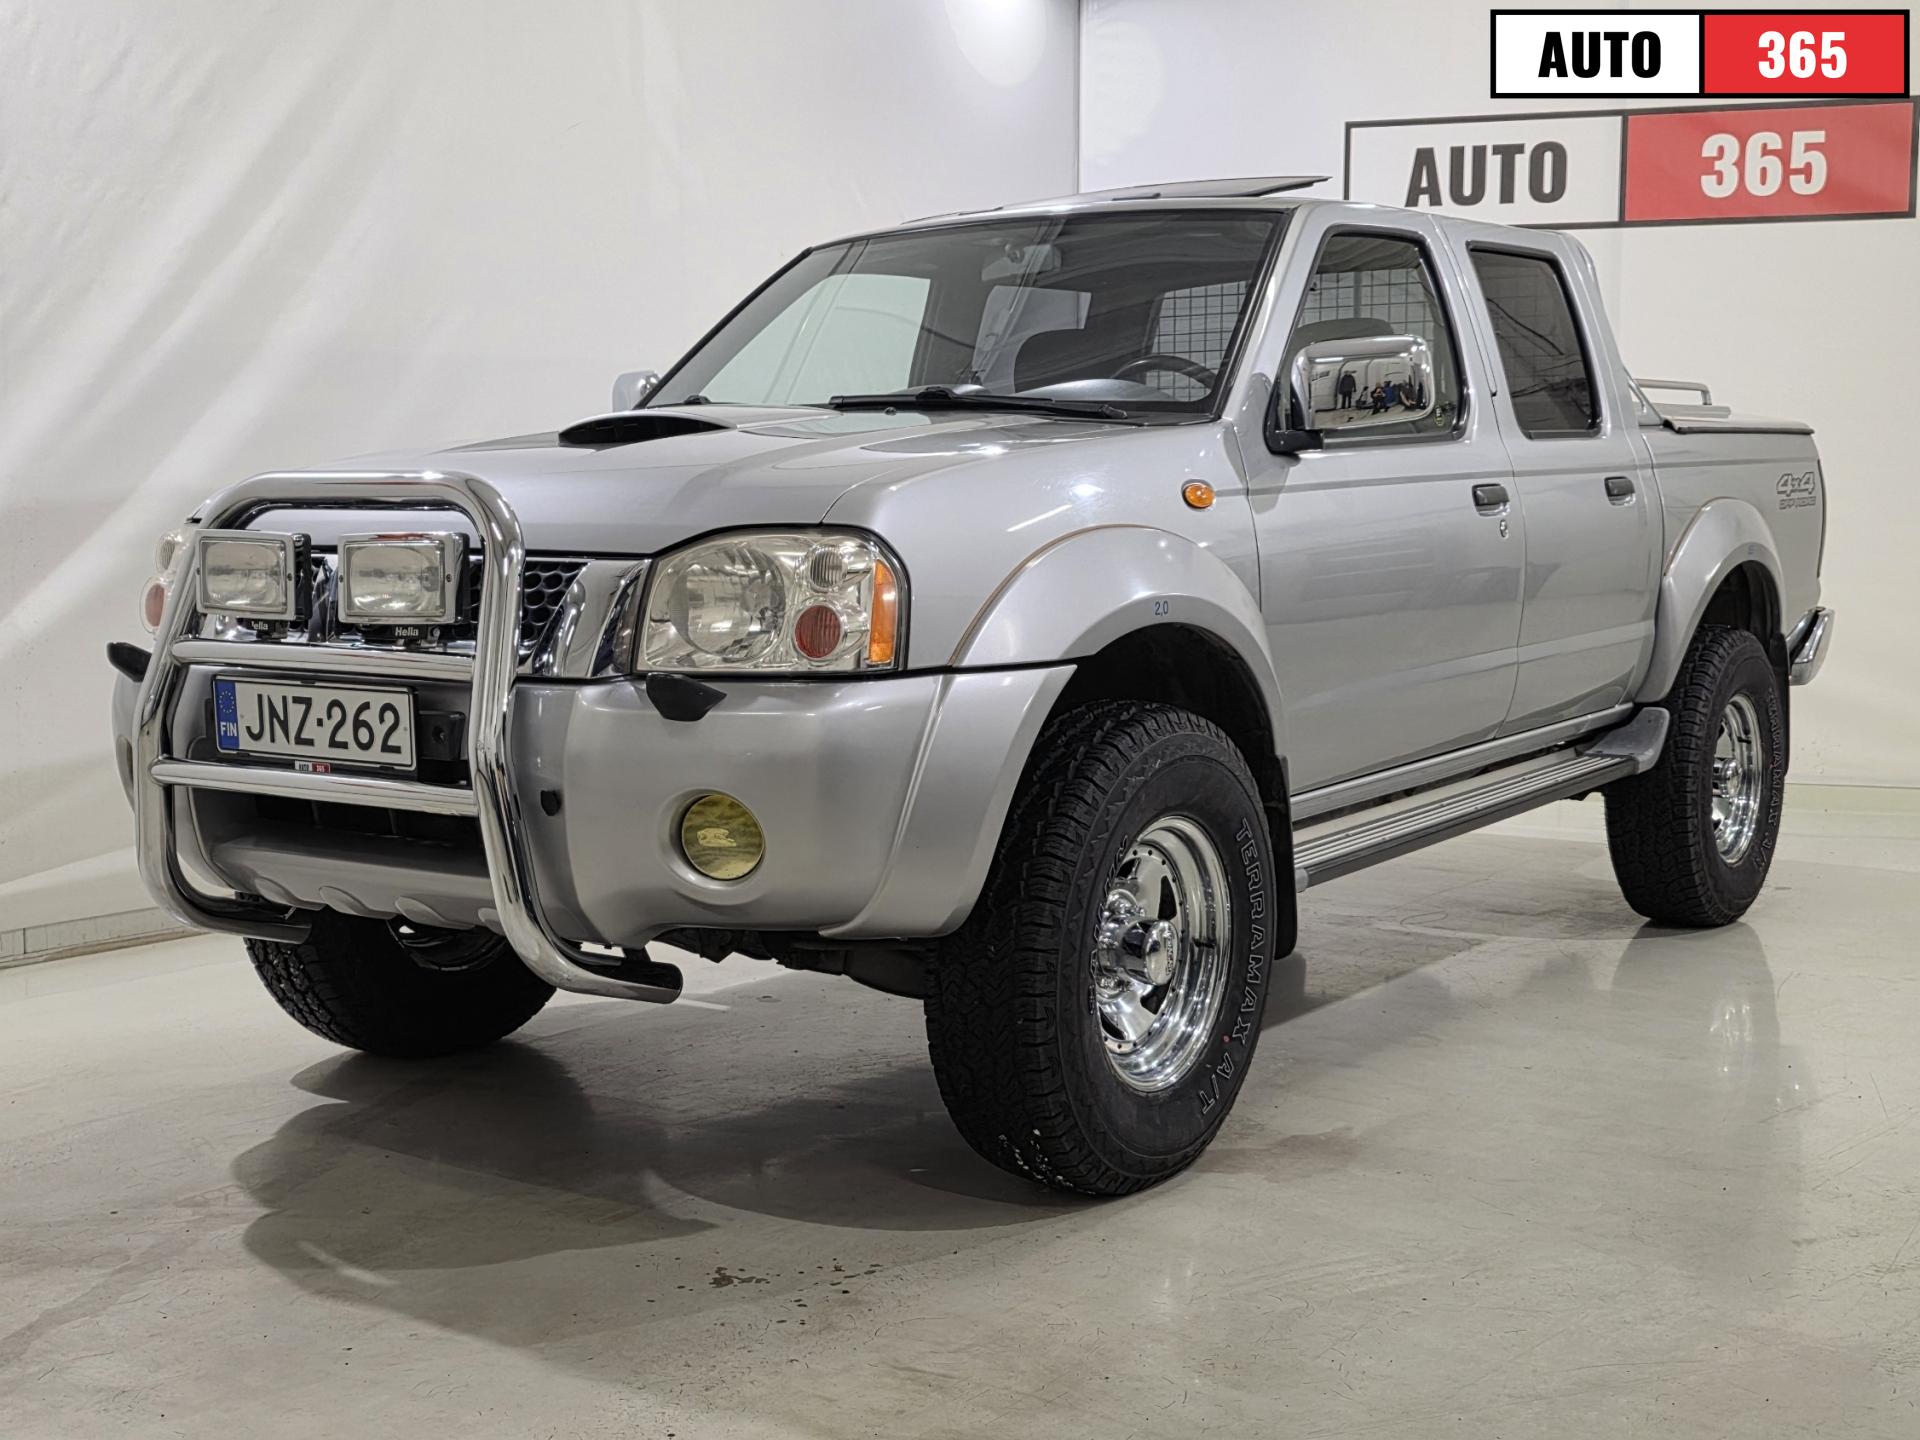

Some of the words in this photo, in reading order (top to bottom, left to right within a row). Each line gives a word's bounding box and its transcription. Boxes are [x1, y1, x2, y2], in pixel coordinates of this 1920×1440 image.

[1404, 141, 1568, 208] AUTO
[1700, 130, 1828, 198] 365
[394, 626, 419, 637] Hella
[220, 720, 238, 737] FIN
[245, 693, 402, 754] JNZ-262
[1232, 817, 1266, 1045] TERRAMAX
[1200, 1053, 1234, 1114] A/T
